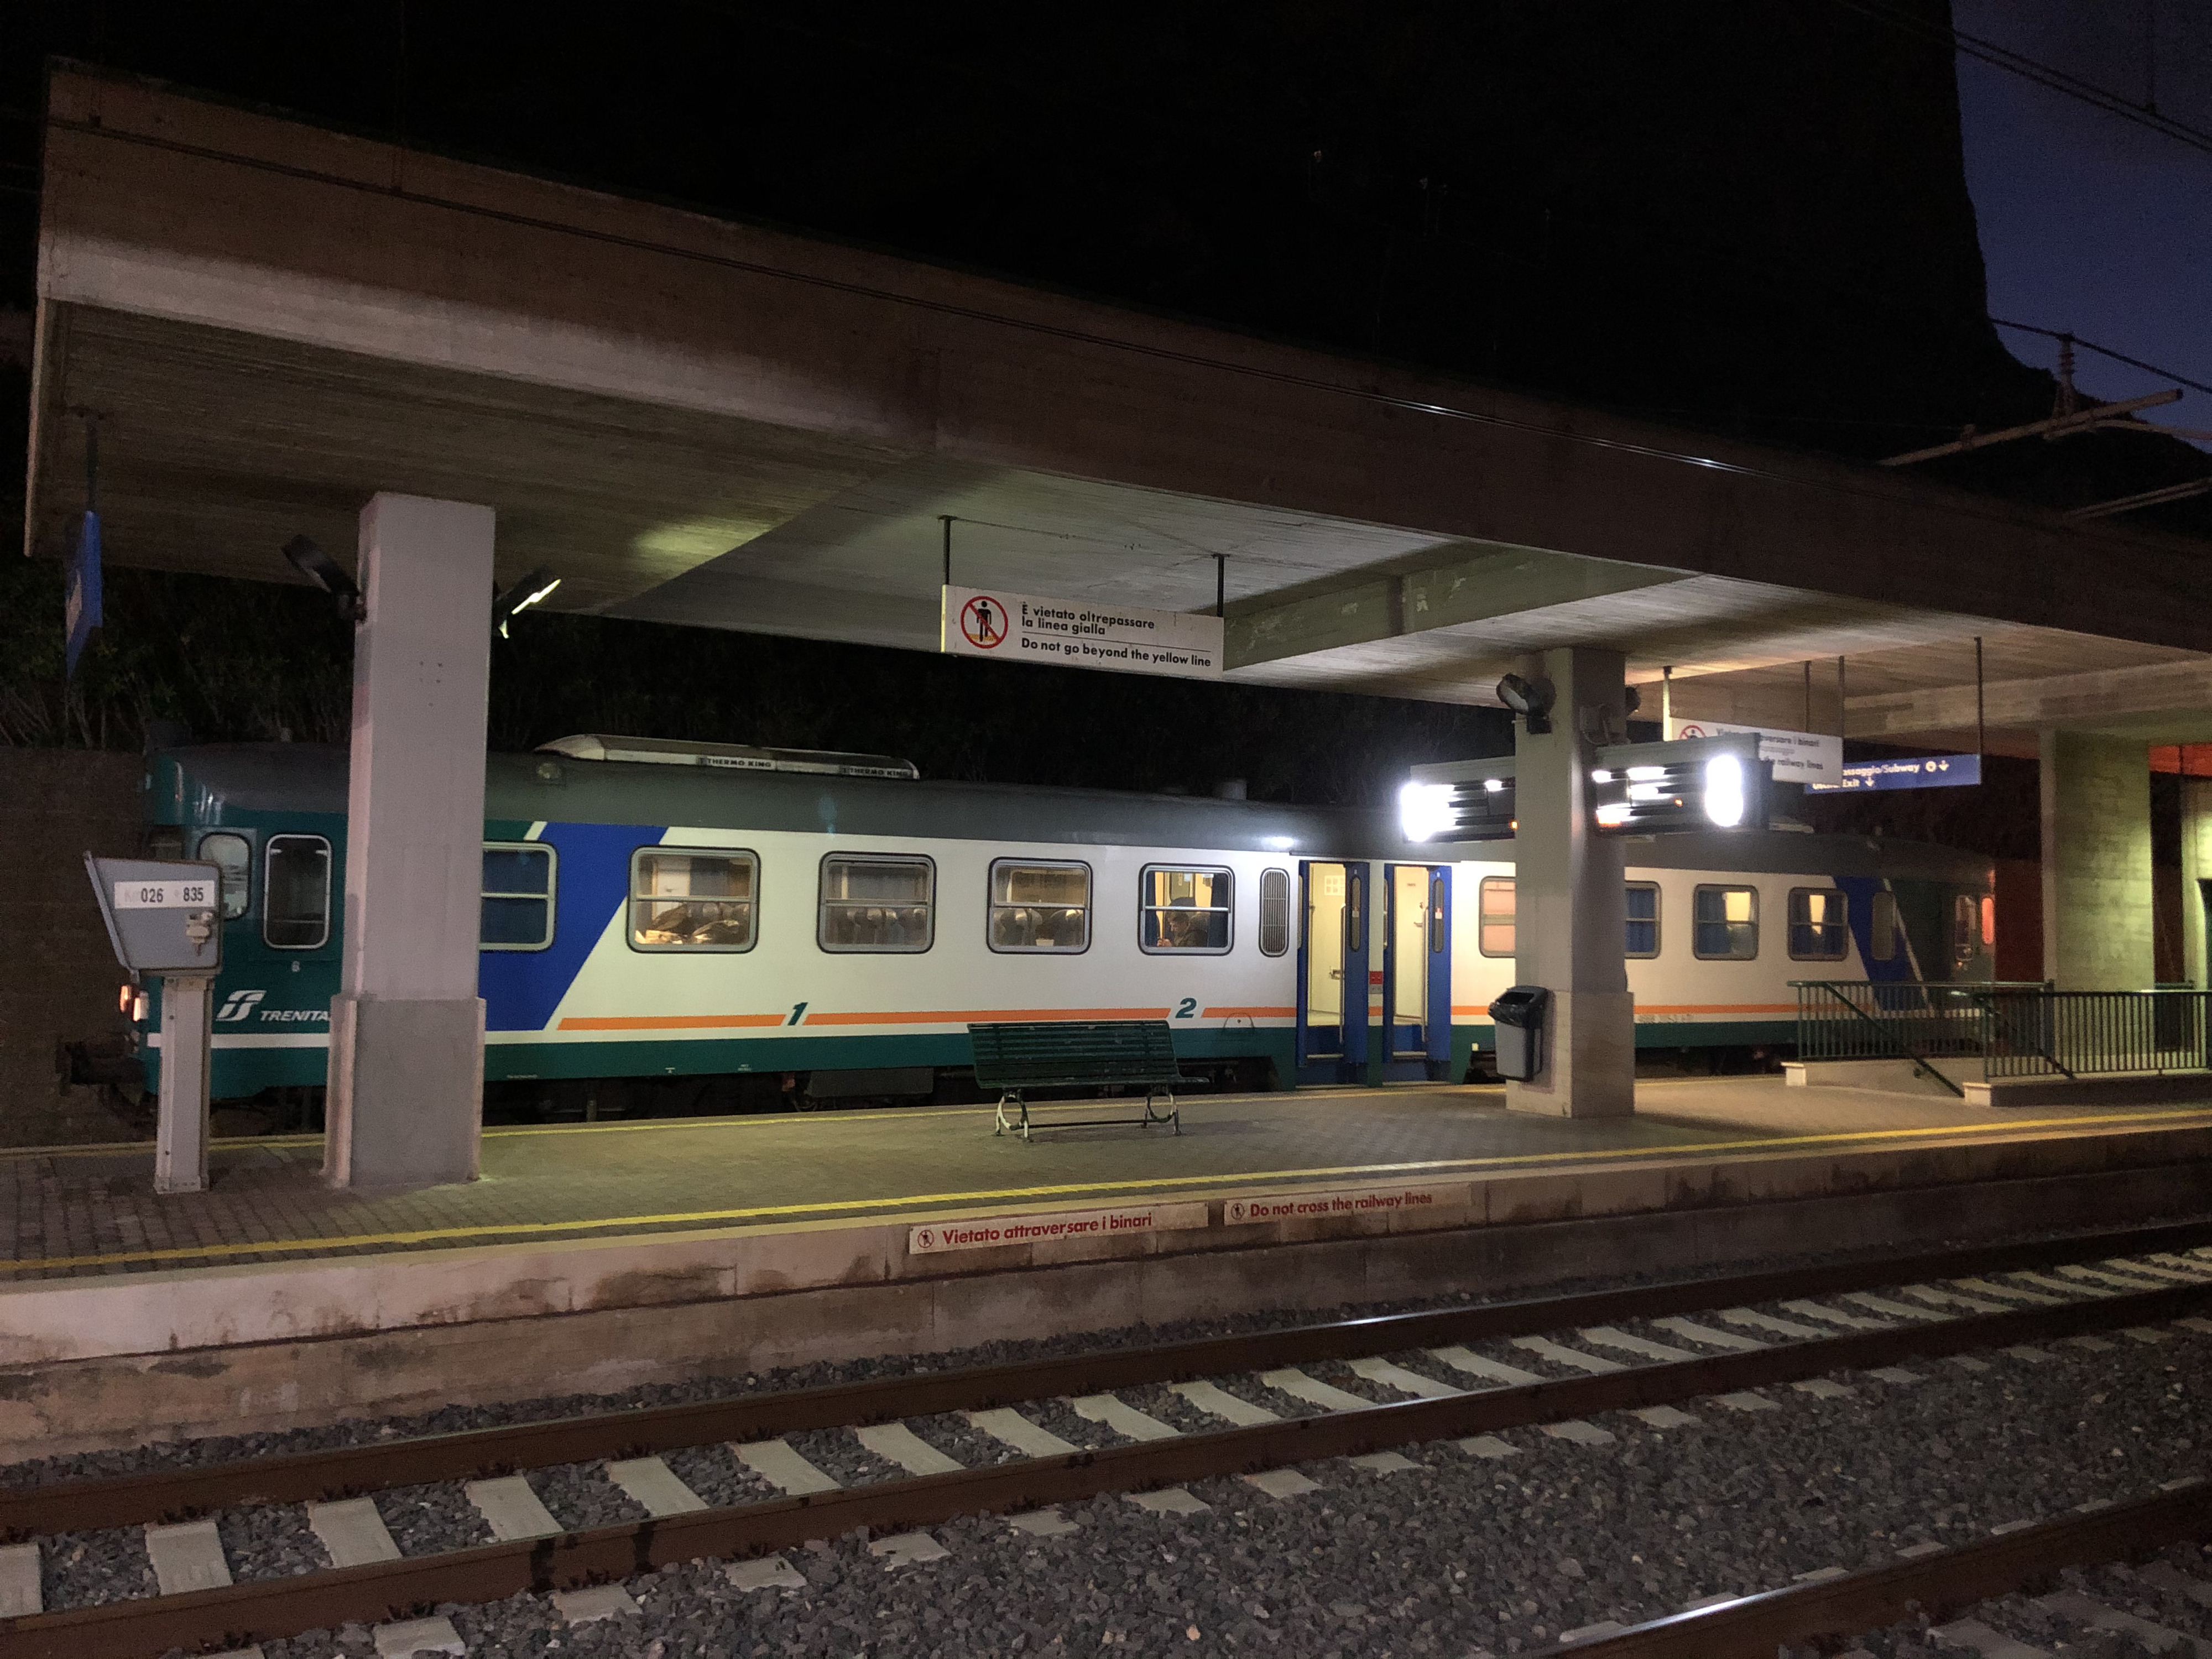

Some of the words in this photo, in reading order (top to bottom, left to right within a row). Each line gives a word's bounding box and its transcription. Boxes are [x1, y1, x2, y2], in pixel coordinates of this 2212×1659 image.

[1022, 615, 1033, 627] la
[1038, 618, 1068, 630] linea
[1072, 622, 1106, 635] gialla
[1033, 606, 1076, 620] vietato
[1079, 611, 1155, 629] oltrepassare
[1022, 638, 1038, 649] Do
[1041, 641, 1060, 651] not
[1065, 644, 1079, 655] go
[1083, 643, 1128, 658] beyond
[1131, 649, 1149, 660] the
[1152, 651, 1189, 664] yellow
[1191, 654, 1211, 666] line
[1806, 760, 1823, 770] lines
[140, 888, 164, 902] 026
[183, 887, 204, 902] 835
[260, 1010, 330, 1021] TRENITA
[787, 1001, 808, 1026] 1
[1175, 997, 1197, 1019] 2
[1250, 1203, 1269, 1217] Do
[1272, 1202, 1294, 1215] not
[1297, 1203, 1329, 1214] cross
[1332, 1197, 1353, 1211] the
[1355, 1194, 1402, 1209] railway
[1405, 1191, 1432, 1206] lines
[942, 1228, 1000, 1245] Vietato
[1004, 1220, 1099, 1239] attraversare
[1102, 1216, 1107, 1230] i
[1110, 1212, 1152, 1229] binari
